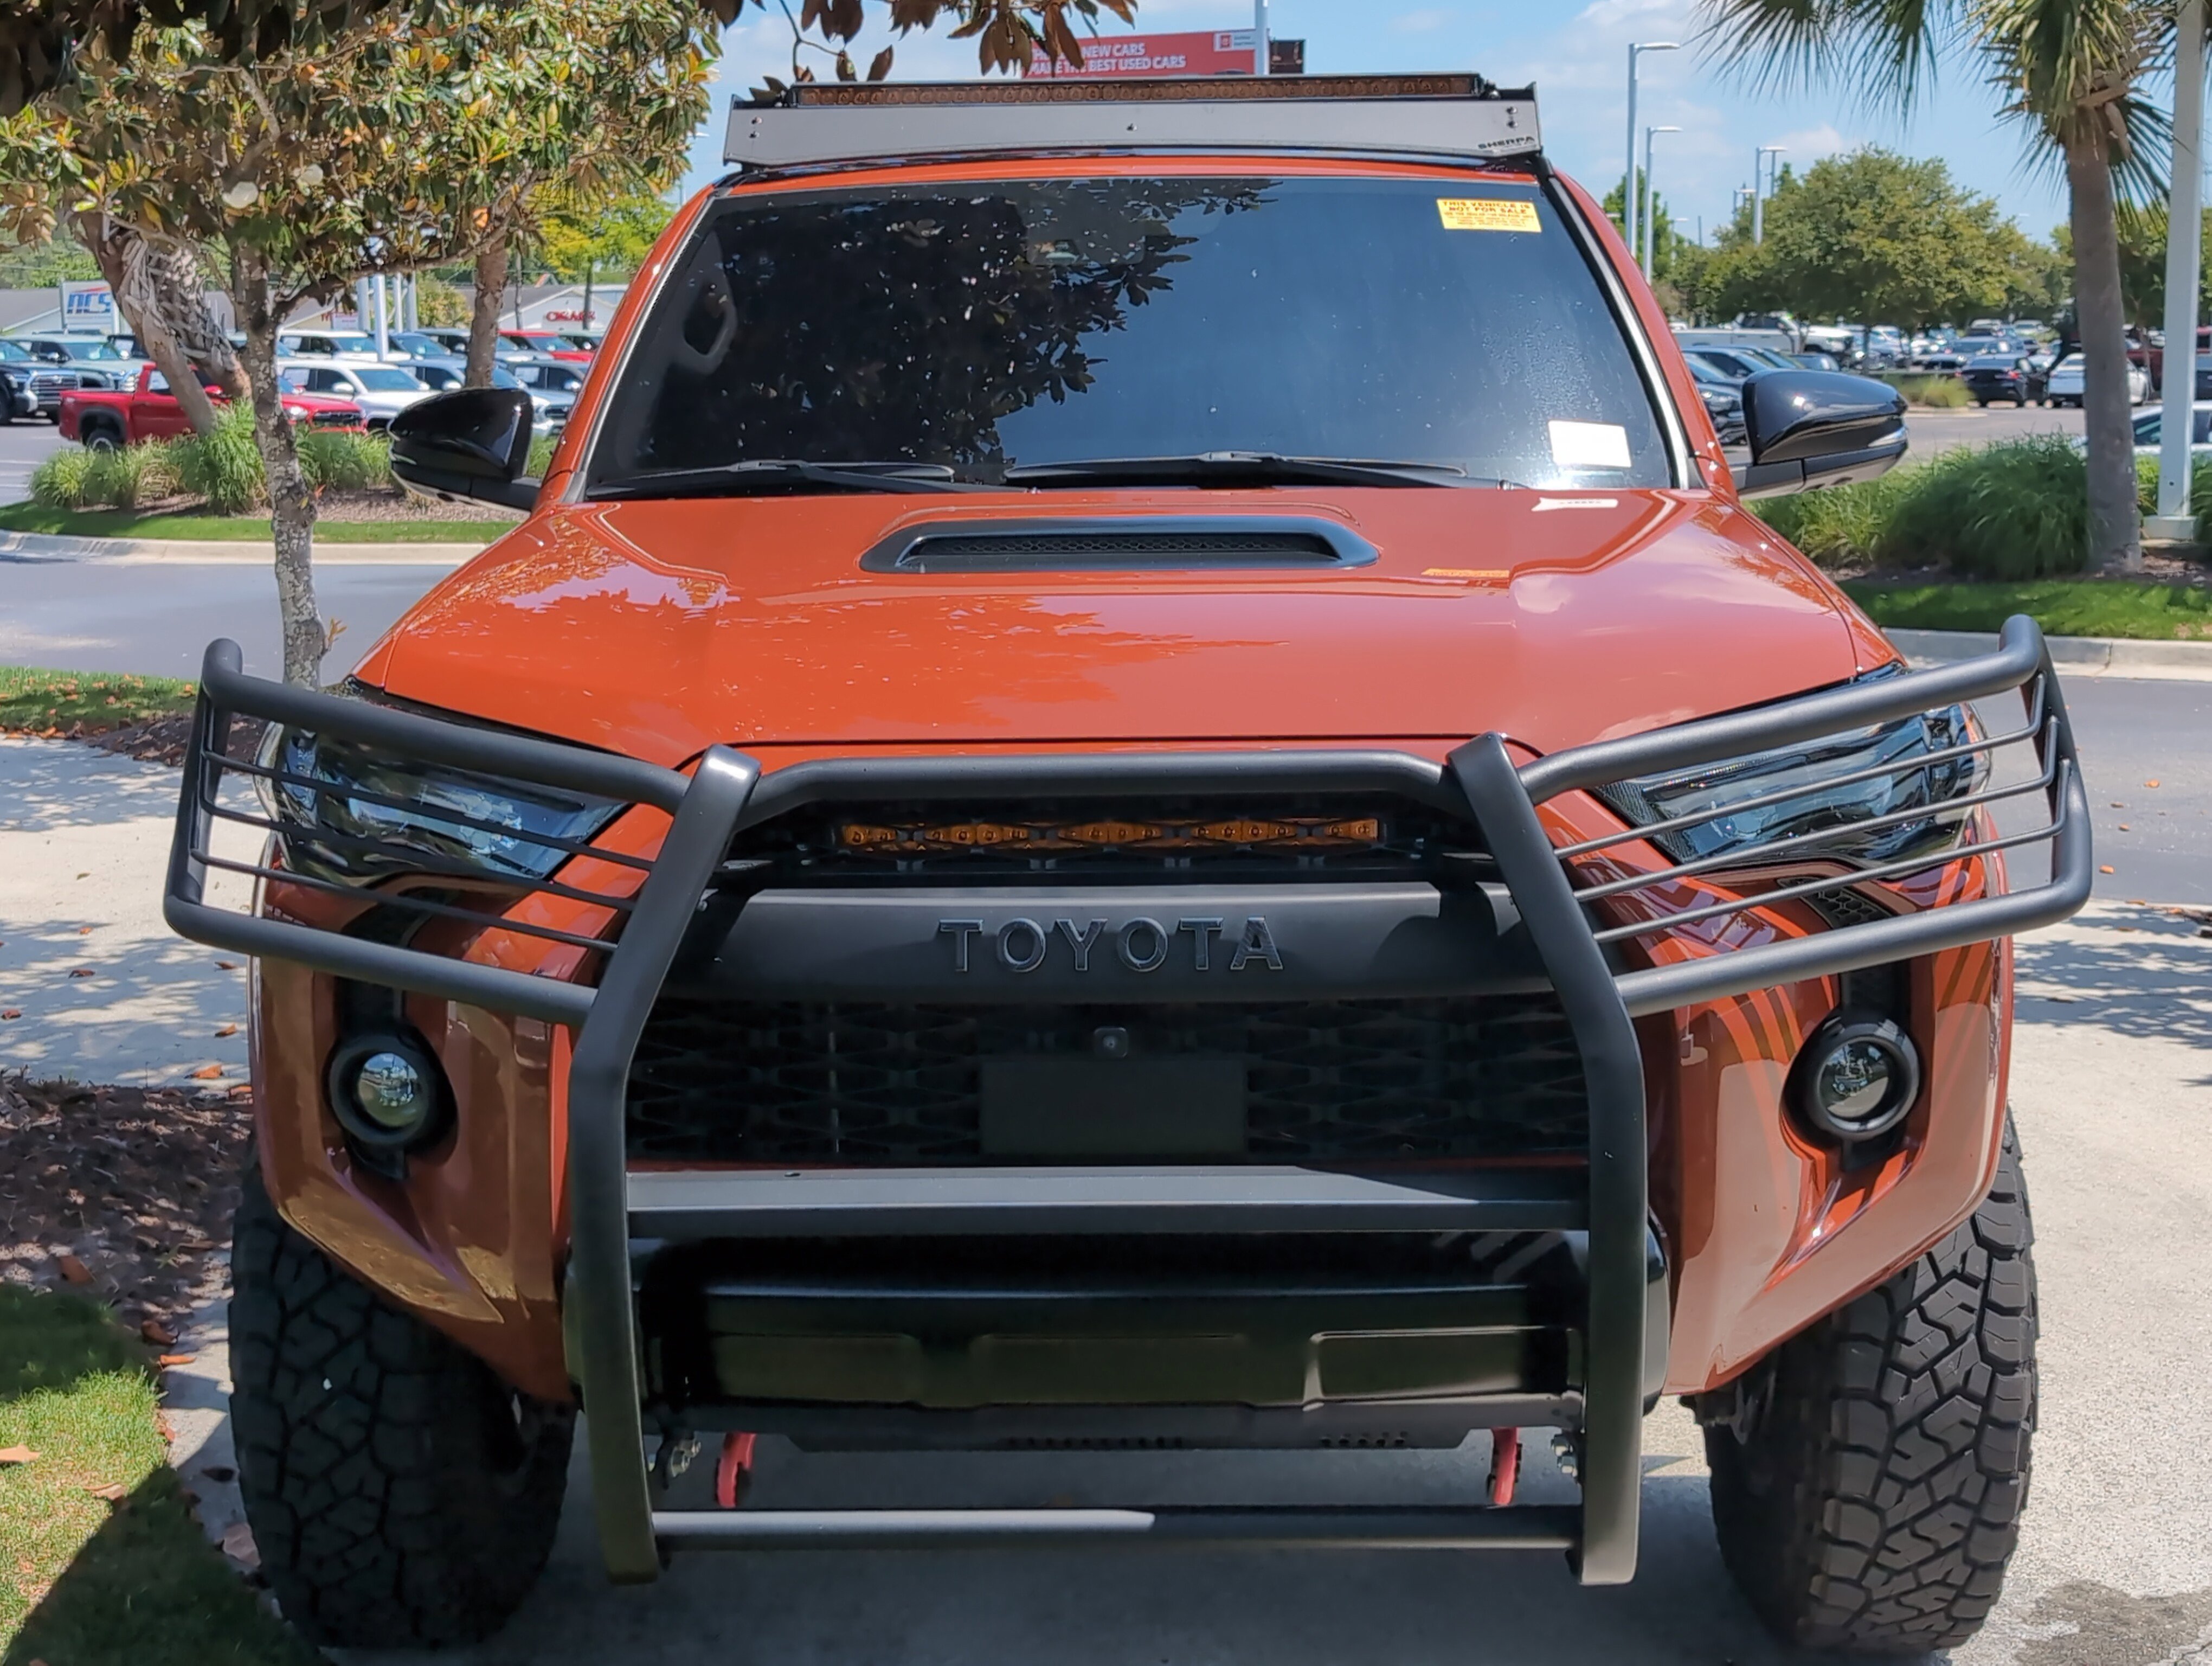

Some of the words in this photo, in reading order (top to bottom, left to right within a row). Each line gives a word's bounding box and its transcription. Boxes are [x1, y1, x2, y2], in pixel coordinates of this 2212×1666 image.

[1082, 45, 1112, 58] NEW
[1113, 43, 1146, 56] CARS
[1089, 59, 1118, 72] BEST
[1118, 57, 1152, 71] USED
[1152, 55, 1186, 69] CARS
[1478, 136, 1535, 149] SHERPA
[938, 915, 1284, 973] TOYOTA
